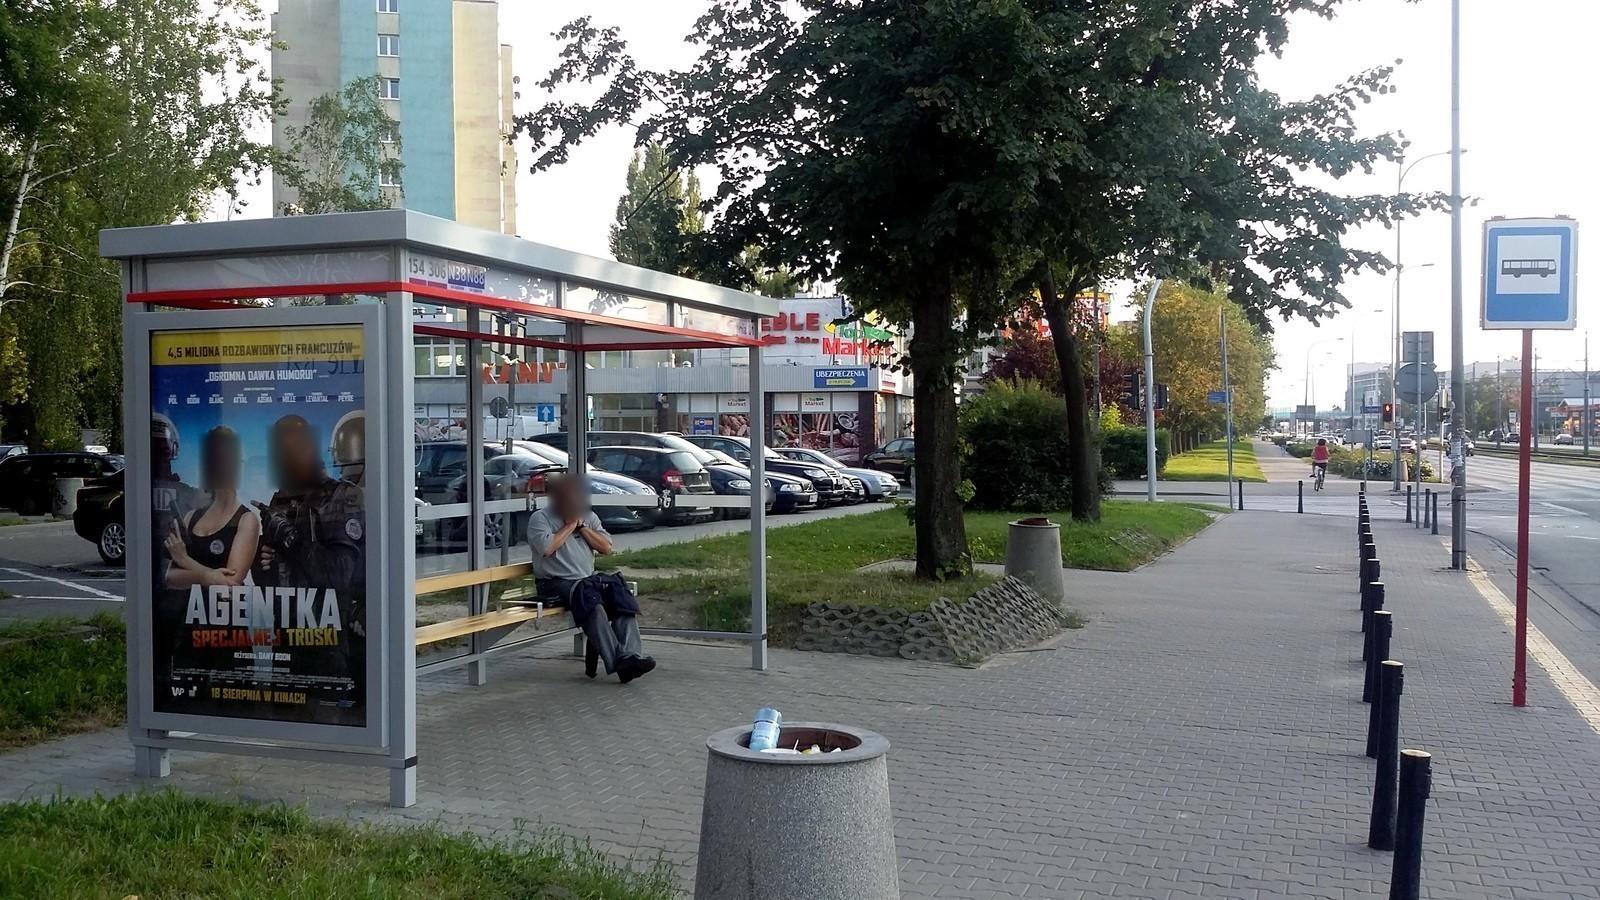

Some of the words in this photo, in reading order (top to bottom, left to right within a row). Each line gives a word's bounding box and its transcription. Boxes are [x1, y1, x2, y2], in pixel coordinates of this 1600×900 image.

[408, 257, 425, 275] 154
[428, 261, 446, 279] 306
[448, 264, 466, 282] N38
[467, 267, 485, 285] N88
[761, 311, 820, 331] EBLE
[167, 346, 183, 359] 4,5
[184, 345, 221, 358] MILIONA
[222, 343, 294, 357] ROZBAWIONYCH
[295, 340, 353, 355] FRANCUZÓW
[247, 370, 275, 381] DAWKA
[815, 370, 866, 378] UBEZPIECZENIA
[185, 584, 342, 630] AGENTKA
[286, 628, 340, 647] TROSKI
[211, 687, 220, 699] 18
[222, 688, 262, 702] SIERPNIA
[263, 690, 272, 702] W
[273, 691, 307, 705] KINACH
